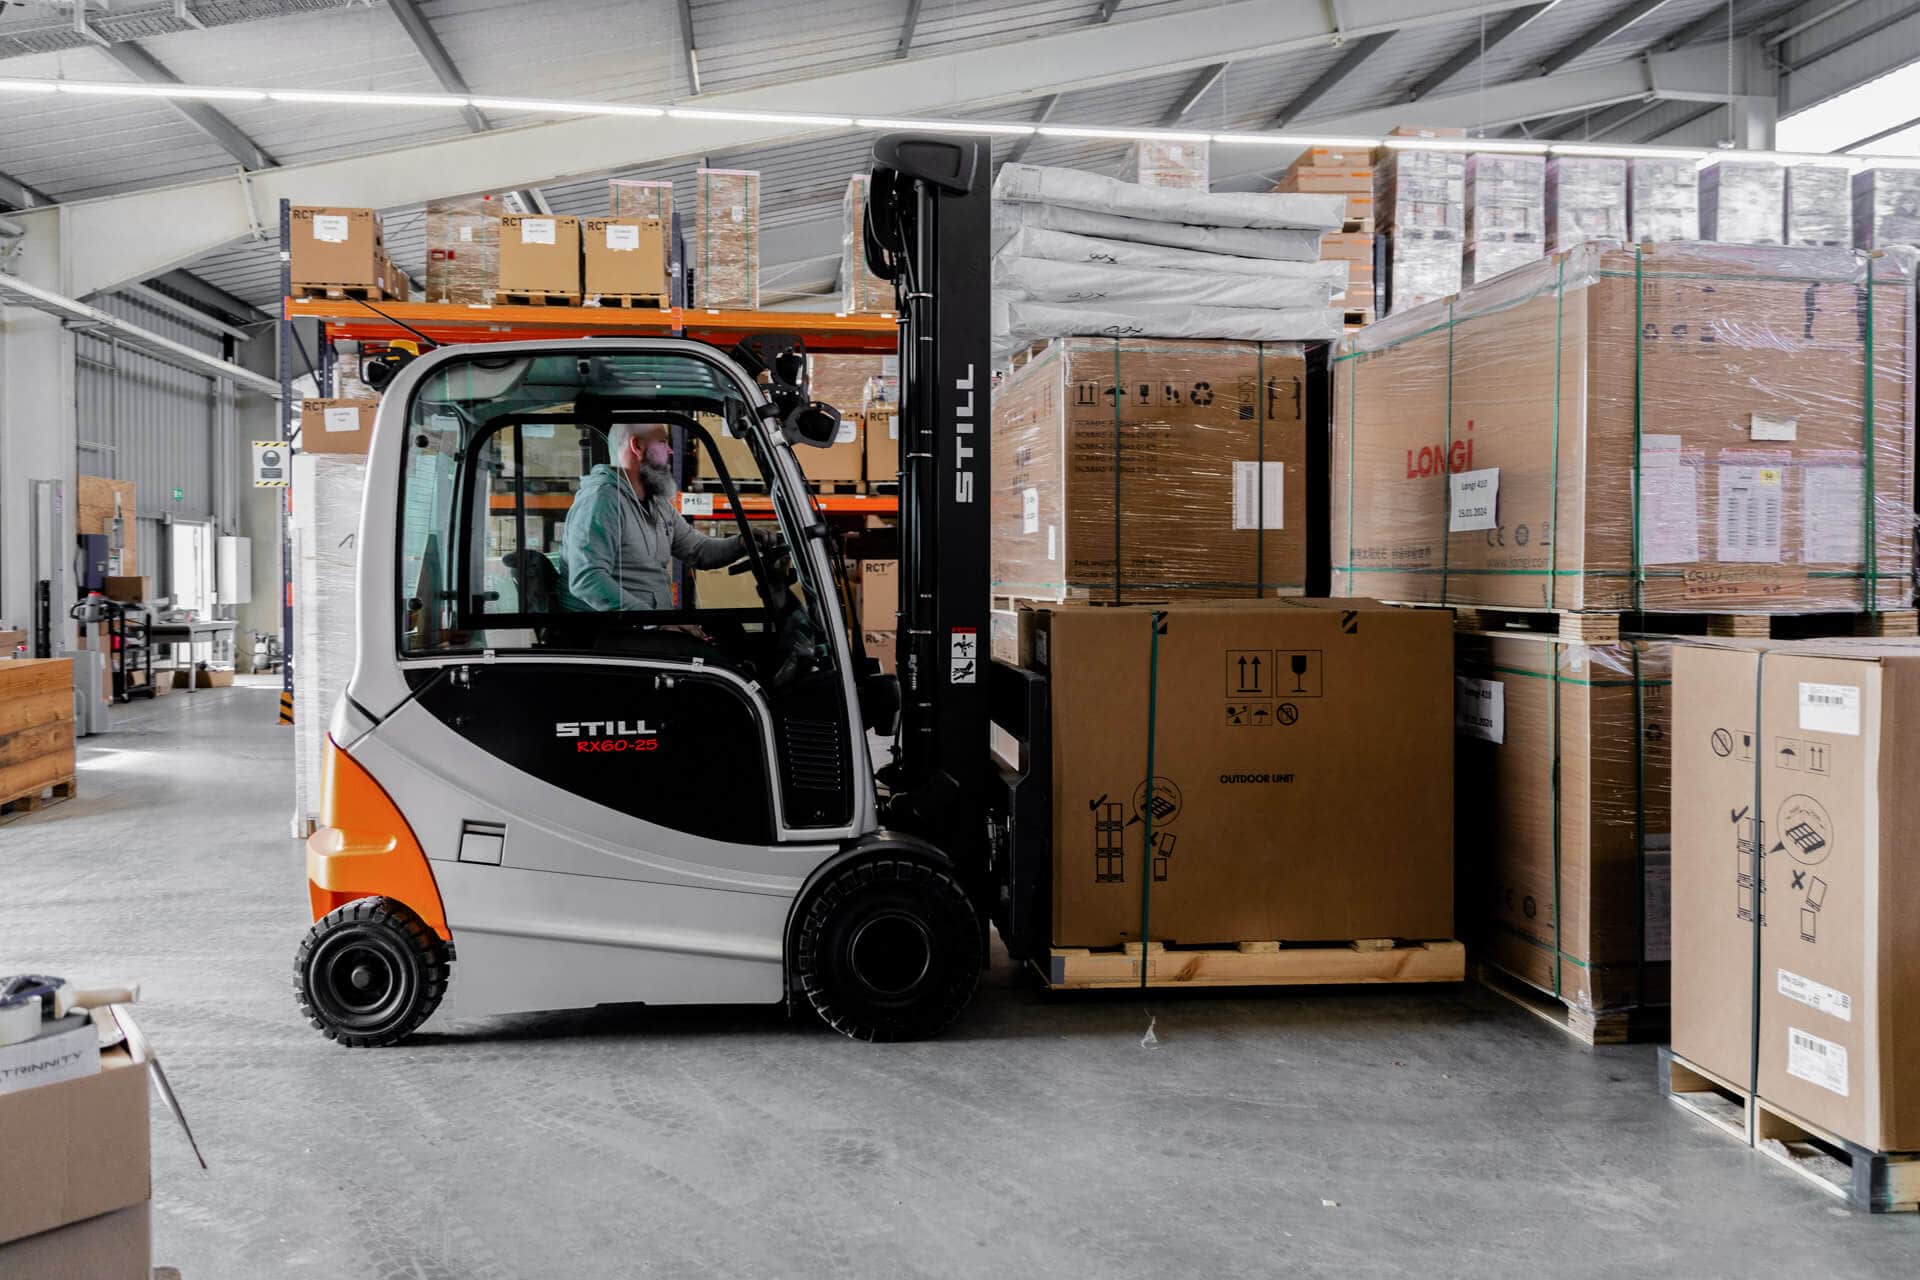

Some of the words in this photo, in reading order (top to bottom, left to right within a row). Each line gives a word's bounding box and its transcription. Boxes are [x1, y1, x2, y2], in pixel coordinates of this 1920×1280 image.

[293, 209, 315, 220] RCT
[502, 217, 523, 227] RCT
[587, 220, 609, 231] RCT
[304, 401, 327, 412] RCT
[869, 412, 890, 422] RCT
[955, 363, 975, 503] STILL
[865, 563, 887, 573] RCT
[555, 719, 657, 737] STILL
[577, 739, 658, 753] RX60-25
[1220, 774, 1270, 784] OUTDOOR
[1271, 774, 1295, 784] UNIT
